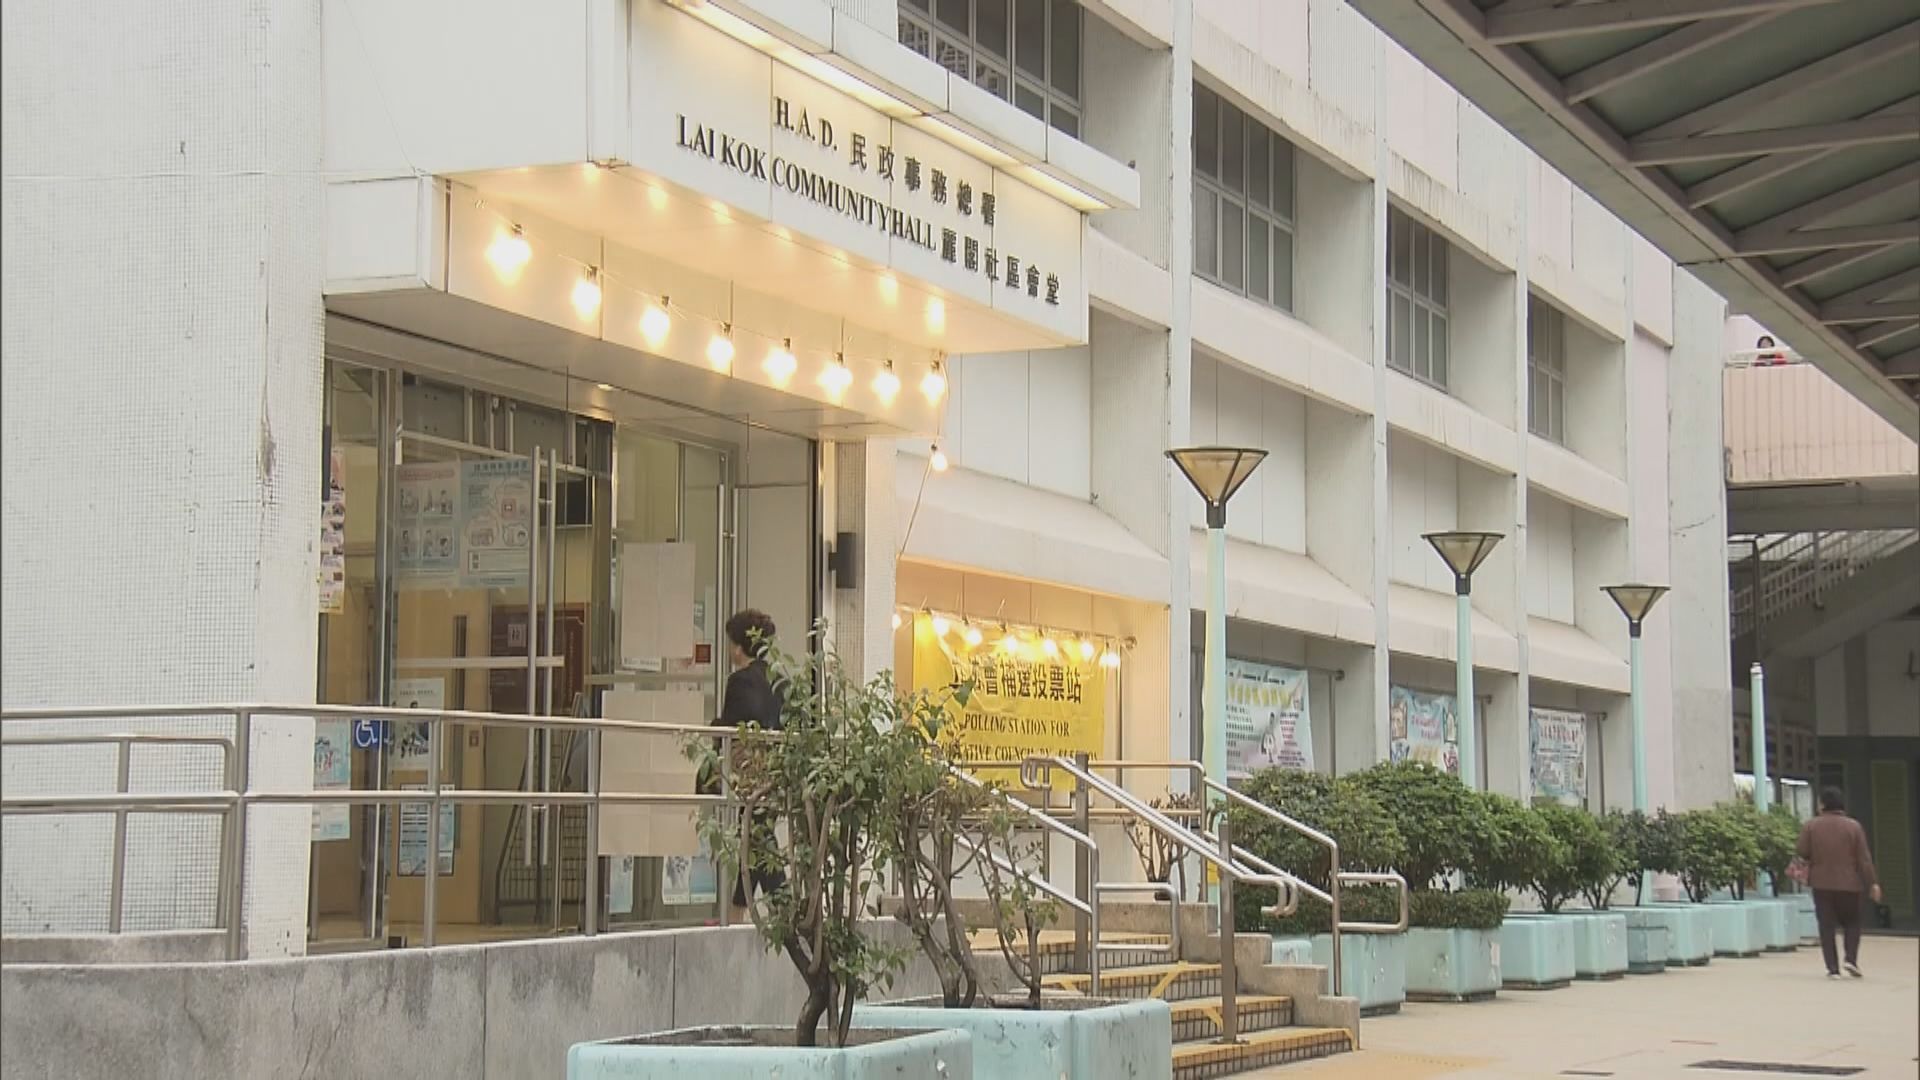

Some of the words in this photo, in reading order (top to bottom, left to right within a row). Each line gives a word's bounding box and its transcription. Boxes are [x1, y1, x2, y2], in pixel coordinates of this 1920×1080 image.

[677, 113, 715, 158] LAI
[721, 133, 767, 181] KOK
[772, 156, 892, 231] COMMUNITY
[891, 207, 937, 251] HALL
[941, 227, 1060, 305] 麗閣社區會堂
[850, 132, 995, 227] 民政事務總署
[963, 713, 1007, 733] POLLING
[1008, 717, 1047, 736] STATION
[1050, 719, 1070, 737] FOR
